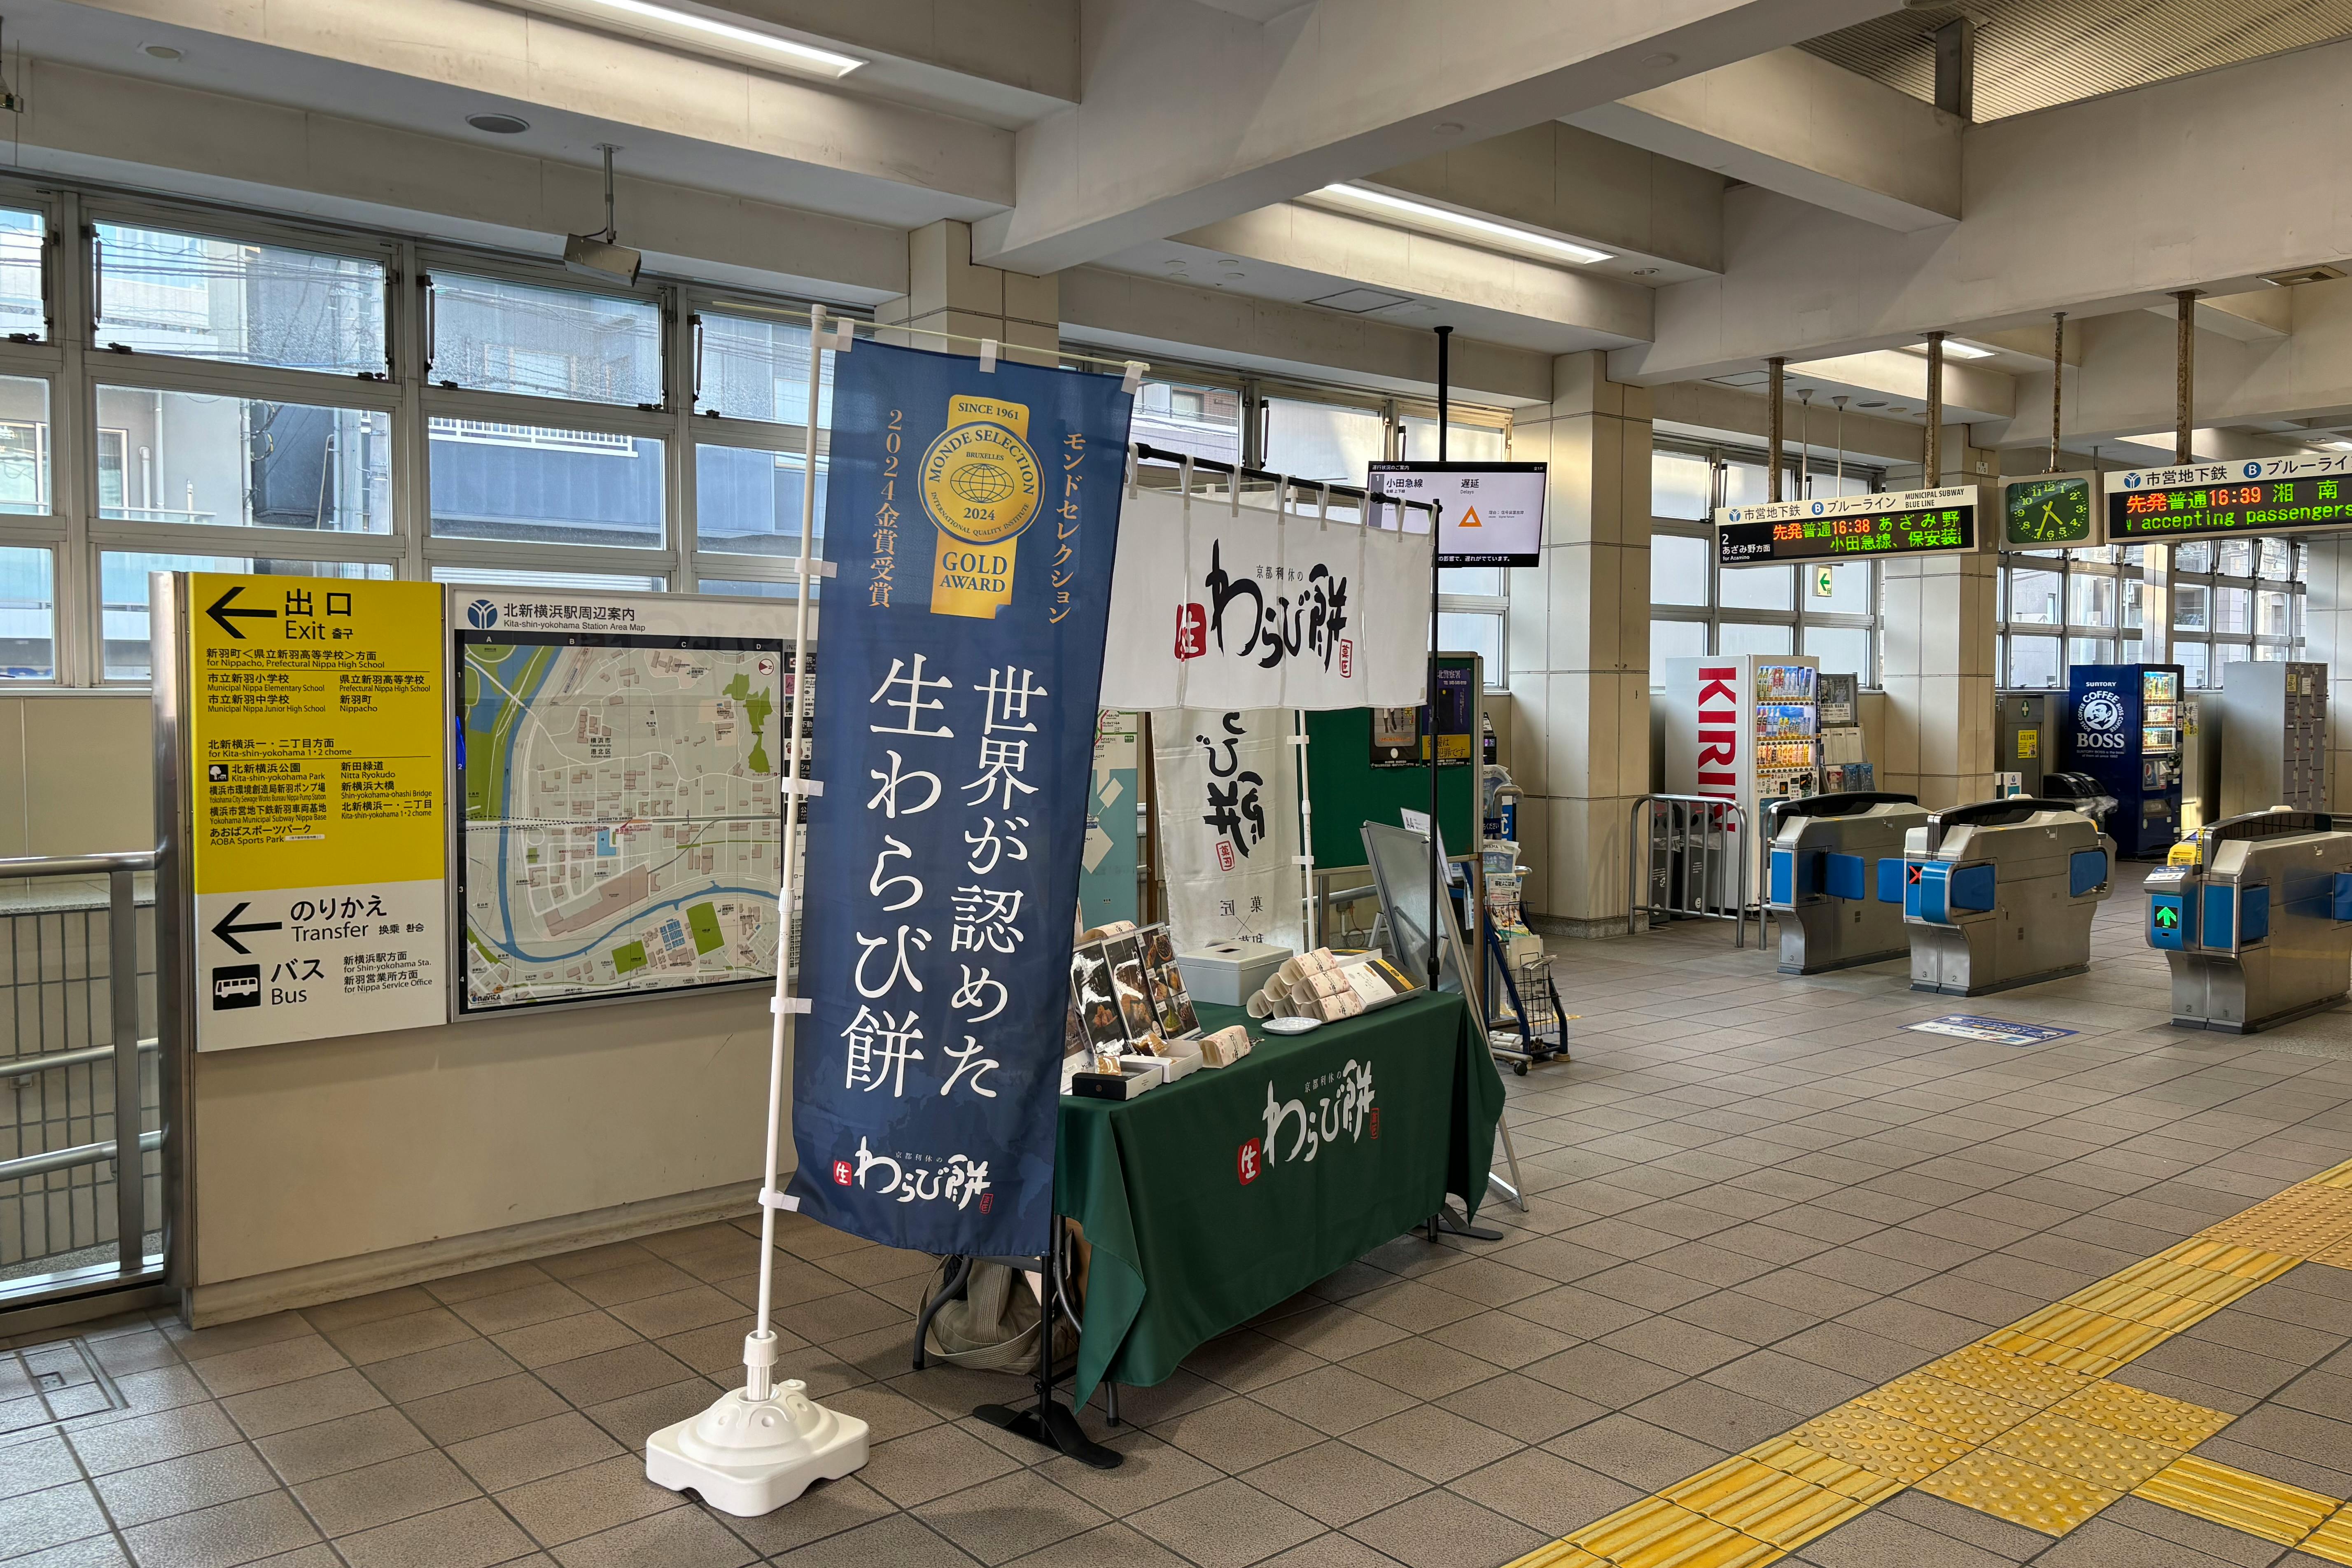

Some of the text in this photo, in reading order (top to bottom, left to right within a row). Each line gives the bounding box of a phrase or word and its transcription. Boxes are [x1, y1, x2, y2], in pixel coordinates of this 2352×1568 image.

[958, 402, 1019, 420] SINCE 1961
[929, 429, 1034, 495] MONDE SELECTION
[966, 452, 1004, 461] BRUXELLES
[2145, 455, 2352, 486] 市営地下鉄 ブルーライ
[1386, 478, 1479, 488] 小田急線 遅延
[1905, 488, 1964, 500] MUNICIPAL SUBWAY
[869, 410, 903, 608] 2024金賞受賞
[931, 492, 1029, 536] INTERNATIONAL QUALITY INSTITUTE
[964, 507, 995, 520] 2024
[1743, 497, 1897, 520] 市営地下鉄 ブルーライン
[2141, 503, 2352, 530] accepting passengers
[1049, 433, 1086, 624] モンドセレクション
[1722, 534, 1729, 544] 2
[1722, 544, 1771, 555] あざみ野方面
[943, 551, 1008, 575] GOLD
[1256, 565, 1303, 581] 京都利休の
[939, 574, 1006, 592] AWARD
[285, 588, 352, 617] 出口
[1205, 538, 1347, 673] わらび餅
[504, 603, 635, 621] 北新横浜駅周辺案内
[286, 620, 353, 640] Exit 출구
[504, 619, 646, 632] Kita-shin-yokohama Station Area Map
[221, 659, 264, 667] Nippacho,
[313, 660, 336, 669] Nippa
[208, 673, 289, 683] 市立新羽小学校
[340, 674, 425, 684] 県立新羽高等学校
[243, 684, 262, 693] Nippa
[265, 684, 301, 693] Elementary
[208, 694, 289, 704] 市立新羽中学校
[340, 694, 372, 704] 新羽町
[2083, 691, 2120, 703] COFFEE
[208, 705, 241, 713] Municipal
[243, 705, 263, 713] Nippa
[287, 705, 302, 714] High
[340, 705, 378, 713] Nippacho
[208, 738, 334, 749] 北新横浜一・二丁目方面
[2077, 733, 2125, 748] BOSS
[223, 749, 305, 758] Kita-shin-yokohama
[232, 763, 300, 773] 北新横浜公園
[341, 761, 384, 771] 新田緑道
[232, 773, 307, 782] Kita-shin-yokohama
[362, 771, 395, 779] Ryokudo
[341, 781, 394, 791] 新横浜大橋
[242, 795, 257, 803] Sewage
[341, 789, 432, 800] Shin-yokohama-ohashi Bridge
[210, 803, 327, 817] 横浜市営地下鉄新羽車両基地
[342, 800, 432, 811] 北新横浜一・二丁目
[210, 816, 241, 825] Yokohama
[243, 814, 271, 824] Municipal
[273, 814, 294, 823] Subway
[296, 814, 313, 822] Nippa
[342, 811, 399, 819] Kita-shin-yokohama
[1406, 817, 1415, 829] A4
[210, 824, 311, 837] あおばスポーツパーク
[211, 838, 235, 846] AOBA
[239, 837, 264, 846] Sports
[840, 653, 954, 1098] 生わらび餅
[940, 665, 1048, 1097] 世界が認めた
[290, 895, 387, 922] のりかえ
[291, 922, 369, 942] Transfer
[406, 923, 425, 933] 환승
[343, 951, 407, 965] 新横浜駅方面
[271, 958, 324, 982] バス
[357, 961, 416, 972] Shin-yokohama
[344, 969, 418, 986] 新羽営業所方面
[357, 984, 380, 993] Nippa
[382, 981, 409, 990] Service
[411, 978, 432, 987] Office
[271, 988, 307, 1005] Bus
[1304, 1071, 1342, 1093] 京都利休の
[1262, 1059, 1375, 1169] わらび餅
[854, 1136, 991, 1210] わらび餅
